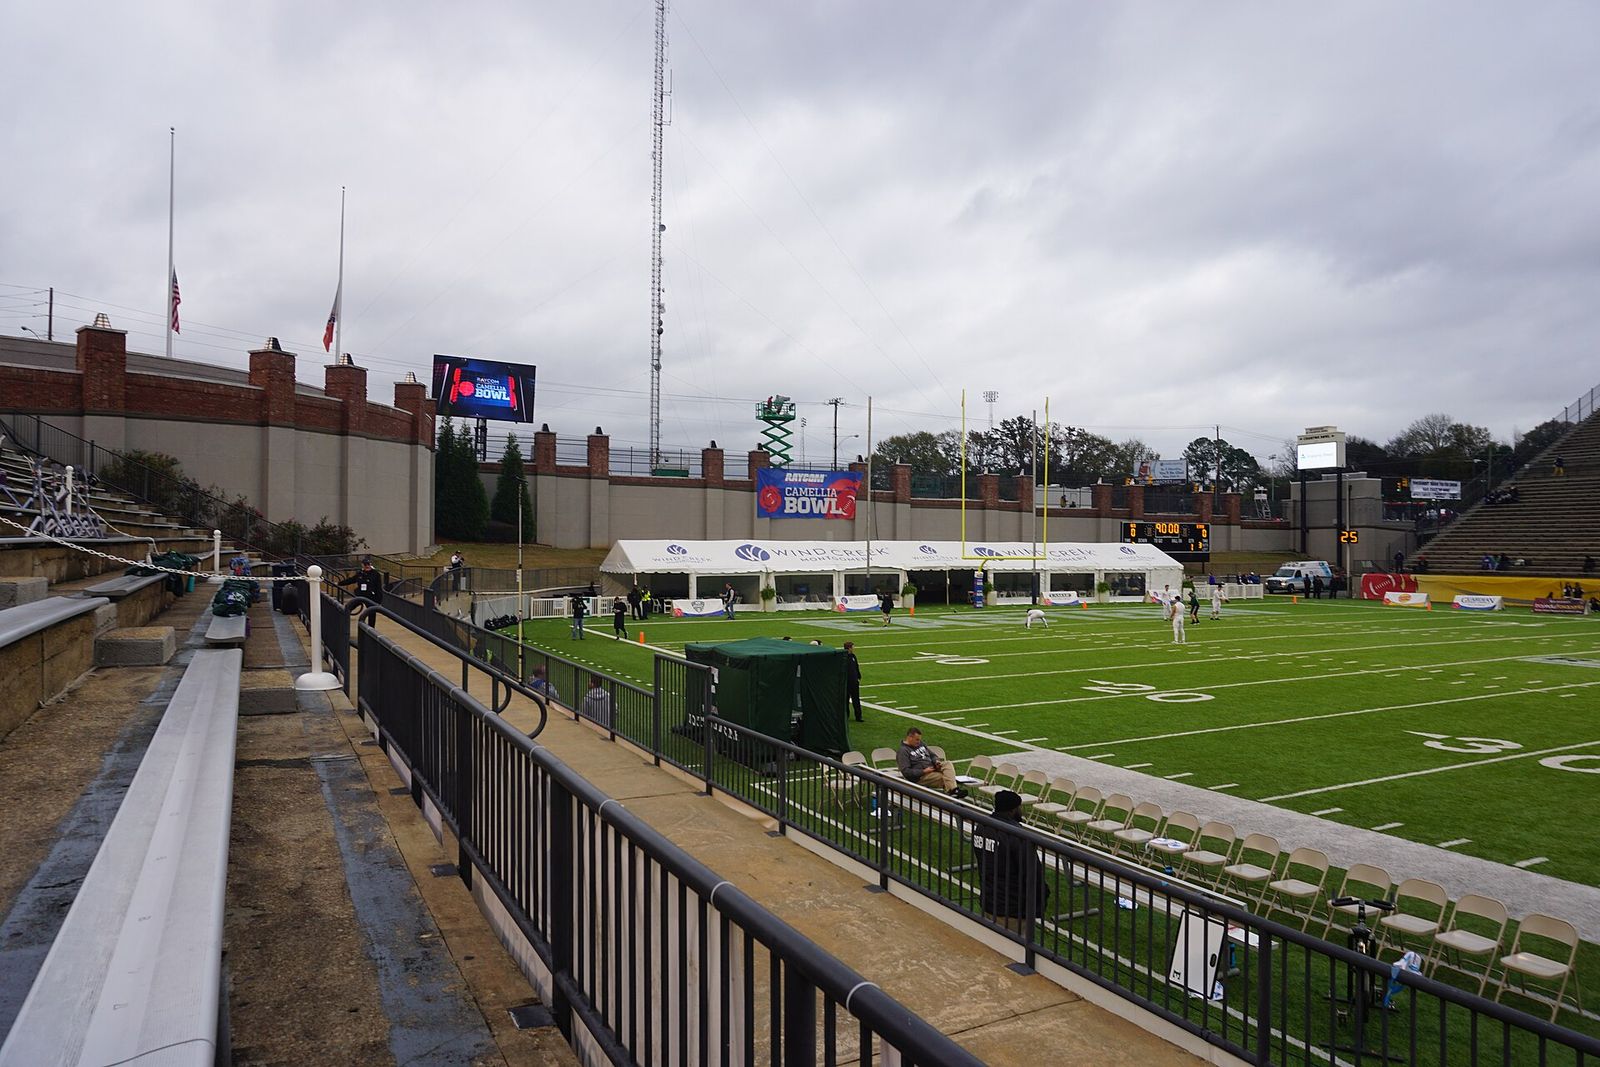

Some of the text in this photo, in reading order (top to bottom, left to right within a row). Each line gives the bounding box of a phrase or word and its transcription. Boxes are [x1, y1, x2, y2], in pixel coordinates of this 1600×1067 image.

[475, 383, 507, 391] CAMELLIA
[475, 388, 510, 401] BOWL
[784, 472, 825, 483] RAYCOM
[785, 487, 838, 498] CAMELLIA
[784, 497, 845, 514] BOWL
[1340, 531, 1358, 543] 25
[771, 548, 827, 557] WIND
